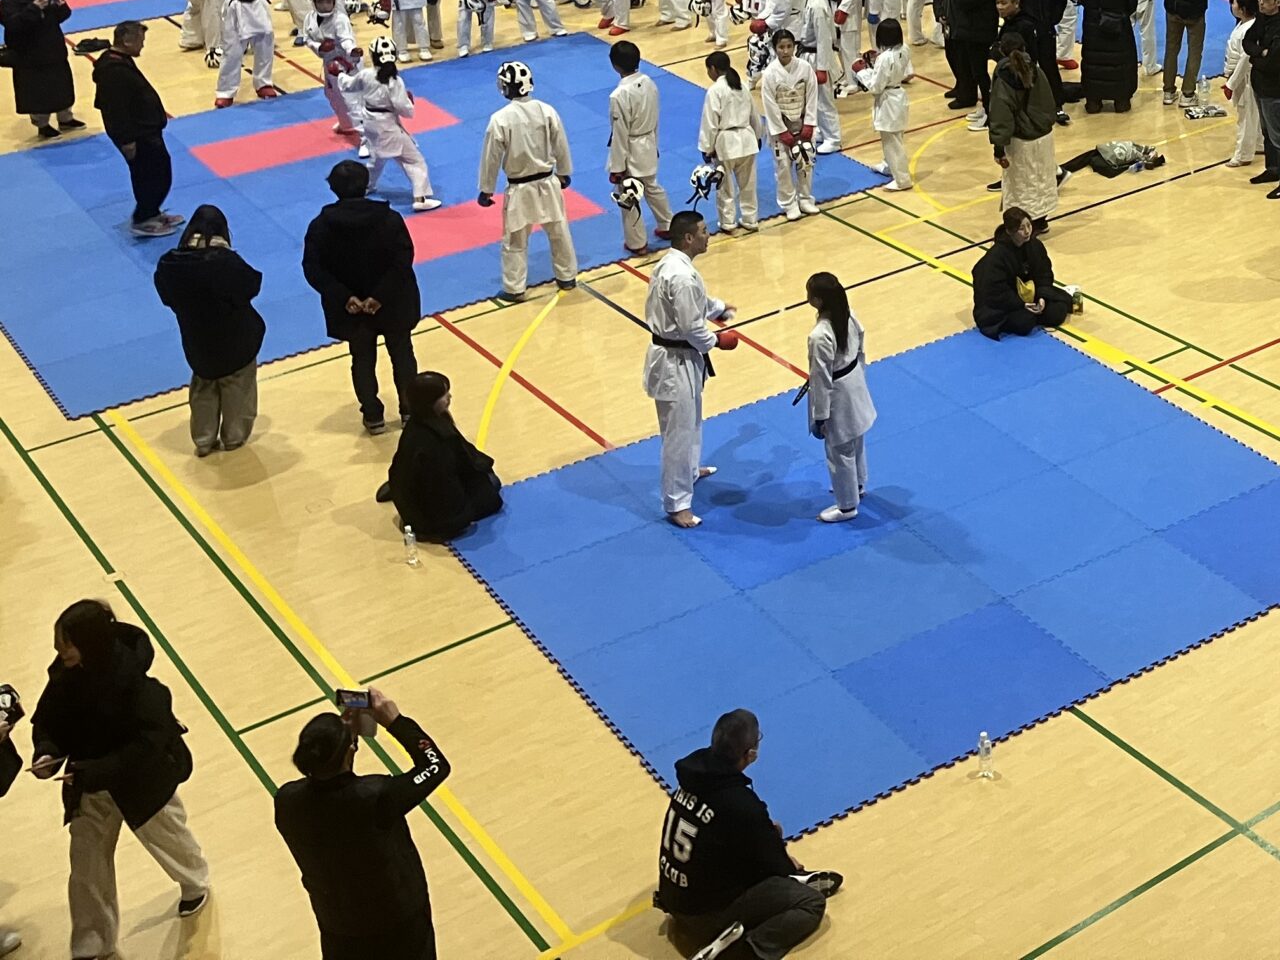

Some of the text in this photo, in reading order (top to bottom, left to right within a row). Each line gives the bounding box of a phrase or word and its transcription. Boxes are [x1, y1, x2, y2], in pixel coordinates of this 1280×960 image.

[696, 803, 715, 823] IS
[663, 807, 699, 863] 15
[660, 855, 688, 888] CLUB
